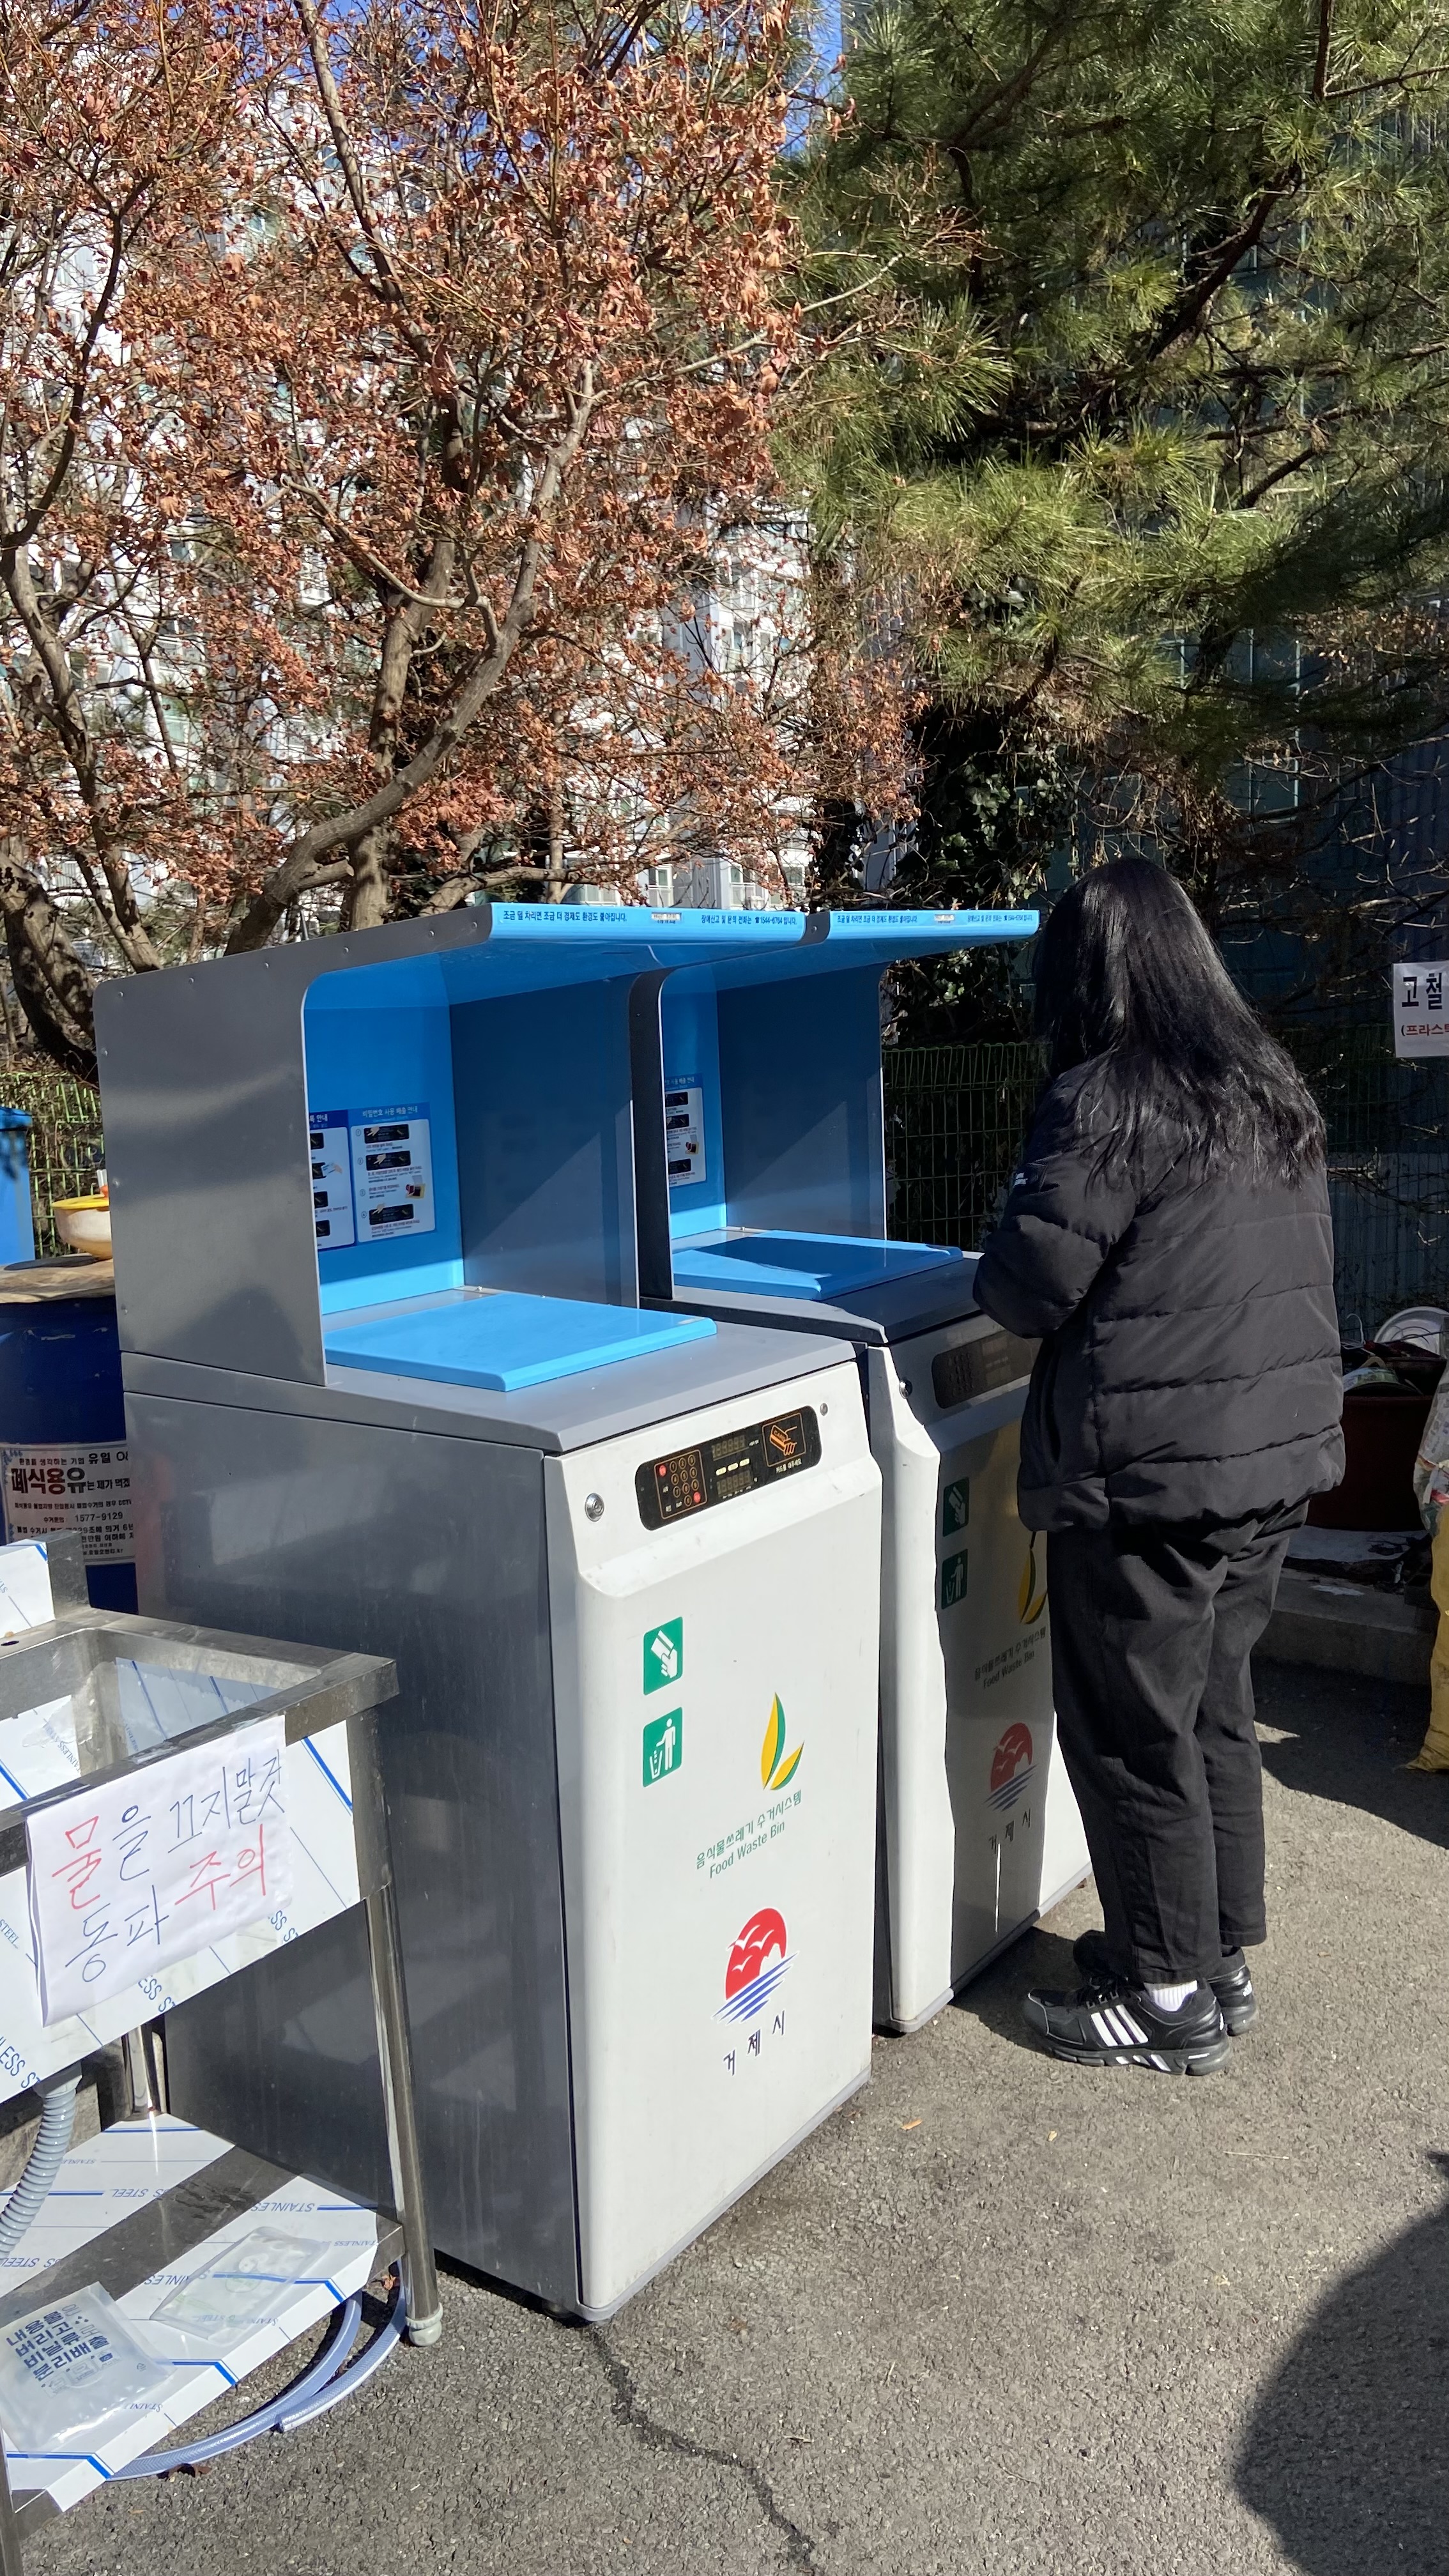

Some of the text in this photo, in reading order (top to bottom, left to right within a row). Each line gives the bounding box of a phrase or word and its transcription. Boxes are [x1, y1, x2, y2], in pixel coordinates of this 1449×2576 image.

[503, 910, 516, 920] 조금
[525, 911, 542, 921] 차리면
[544, 911, 555, 921] 조금
[556, 911, 562, 921] 더
[564, 912, 581, 921] 경제도
[582, 912, 599, 921] 환경도
[727, 915, 736, 924] 문의
[739, 916, 752, 924] 전화는
[40, 1457, 67, 1466] 생각하는
[89, 1452, 111, 1464] 유일
[75, 1512, 123, 1522] 1577-9129
[983, 1671, 1000, 1690] Food
[1002, 1659, 1023, 1677] Waste
[696, 1790, 802, 1869] 음식물쓰레기 수거시스템
[52, 1805, 151, 1910] 물을
[174, 1823, 266, 1910] 주의
[710, 1821, 785, 1878] Food Waste Bin
[111, 2189, 149, 2198] STEEL
[6, 2311, 64, 2346] 내용물
[15, 2322, 73, 2357] 버리고
[24, 2332, 80, 2369] 비닐류
[33, 2335, 111, 2382] 분리배출
